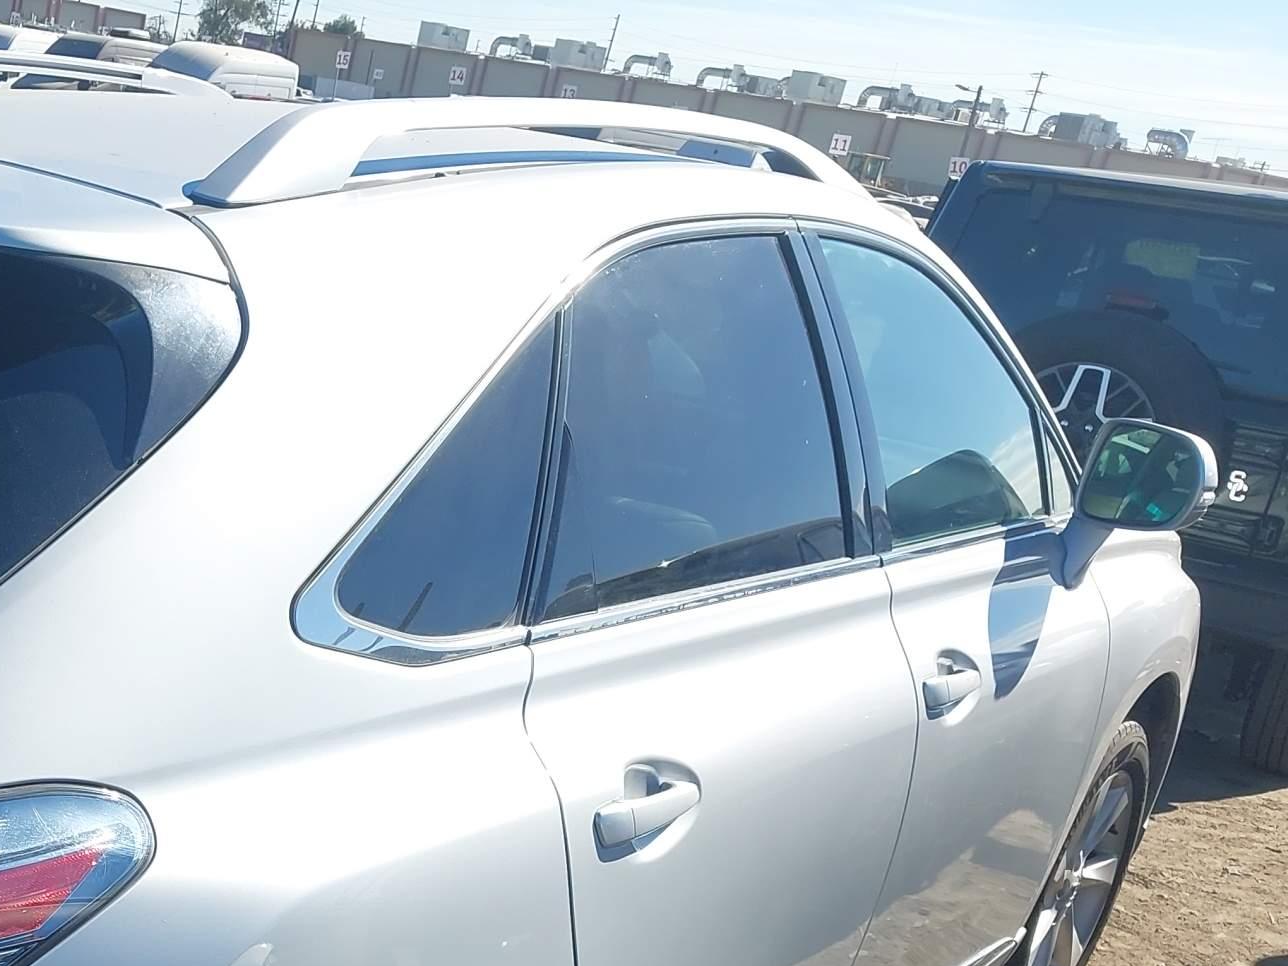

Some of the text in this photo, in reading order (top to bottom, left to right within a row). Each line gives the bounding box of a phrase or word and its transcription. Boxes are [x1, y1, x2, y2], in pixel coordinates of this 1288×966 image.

[336, 53, 350, 66] 15
[450, 69, 465, 82] 14
[562, 87, 576, 99] 13
[831, 137, 848, 152] 11
[949, 160, 968, 174] 10
